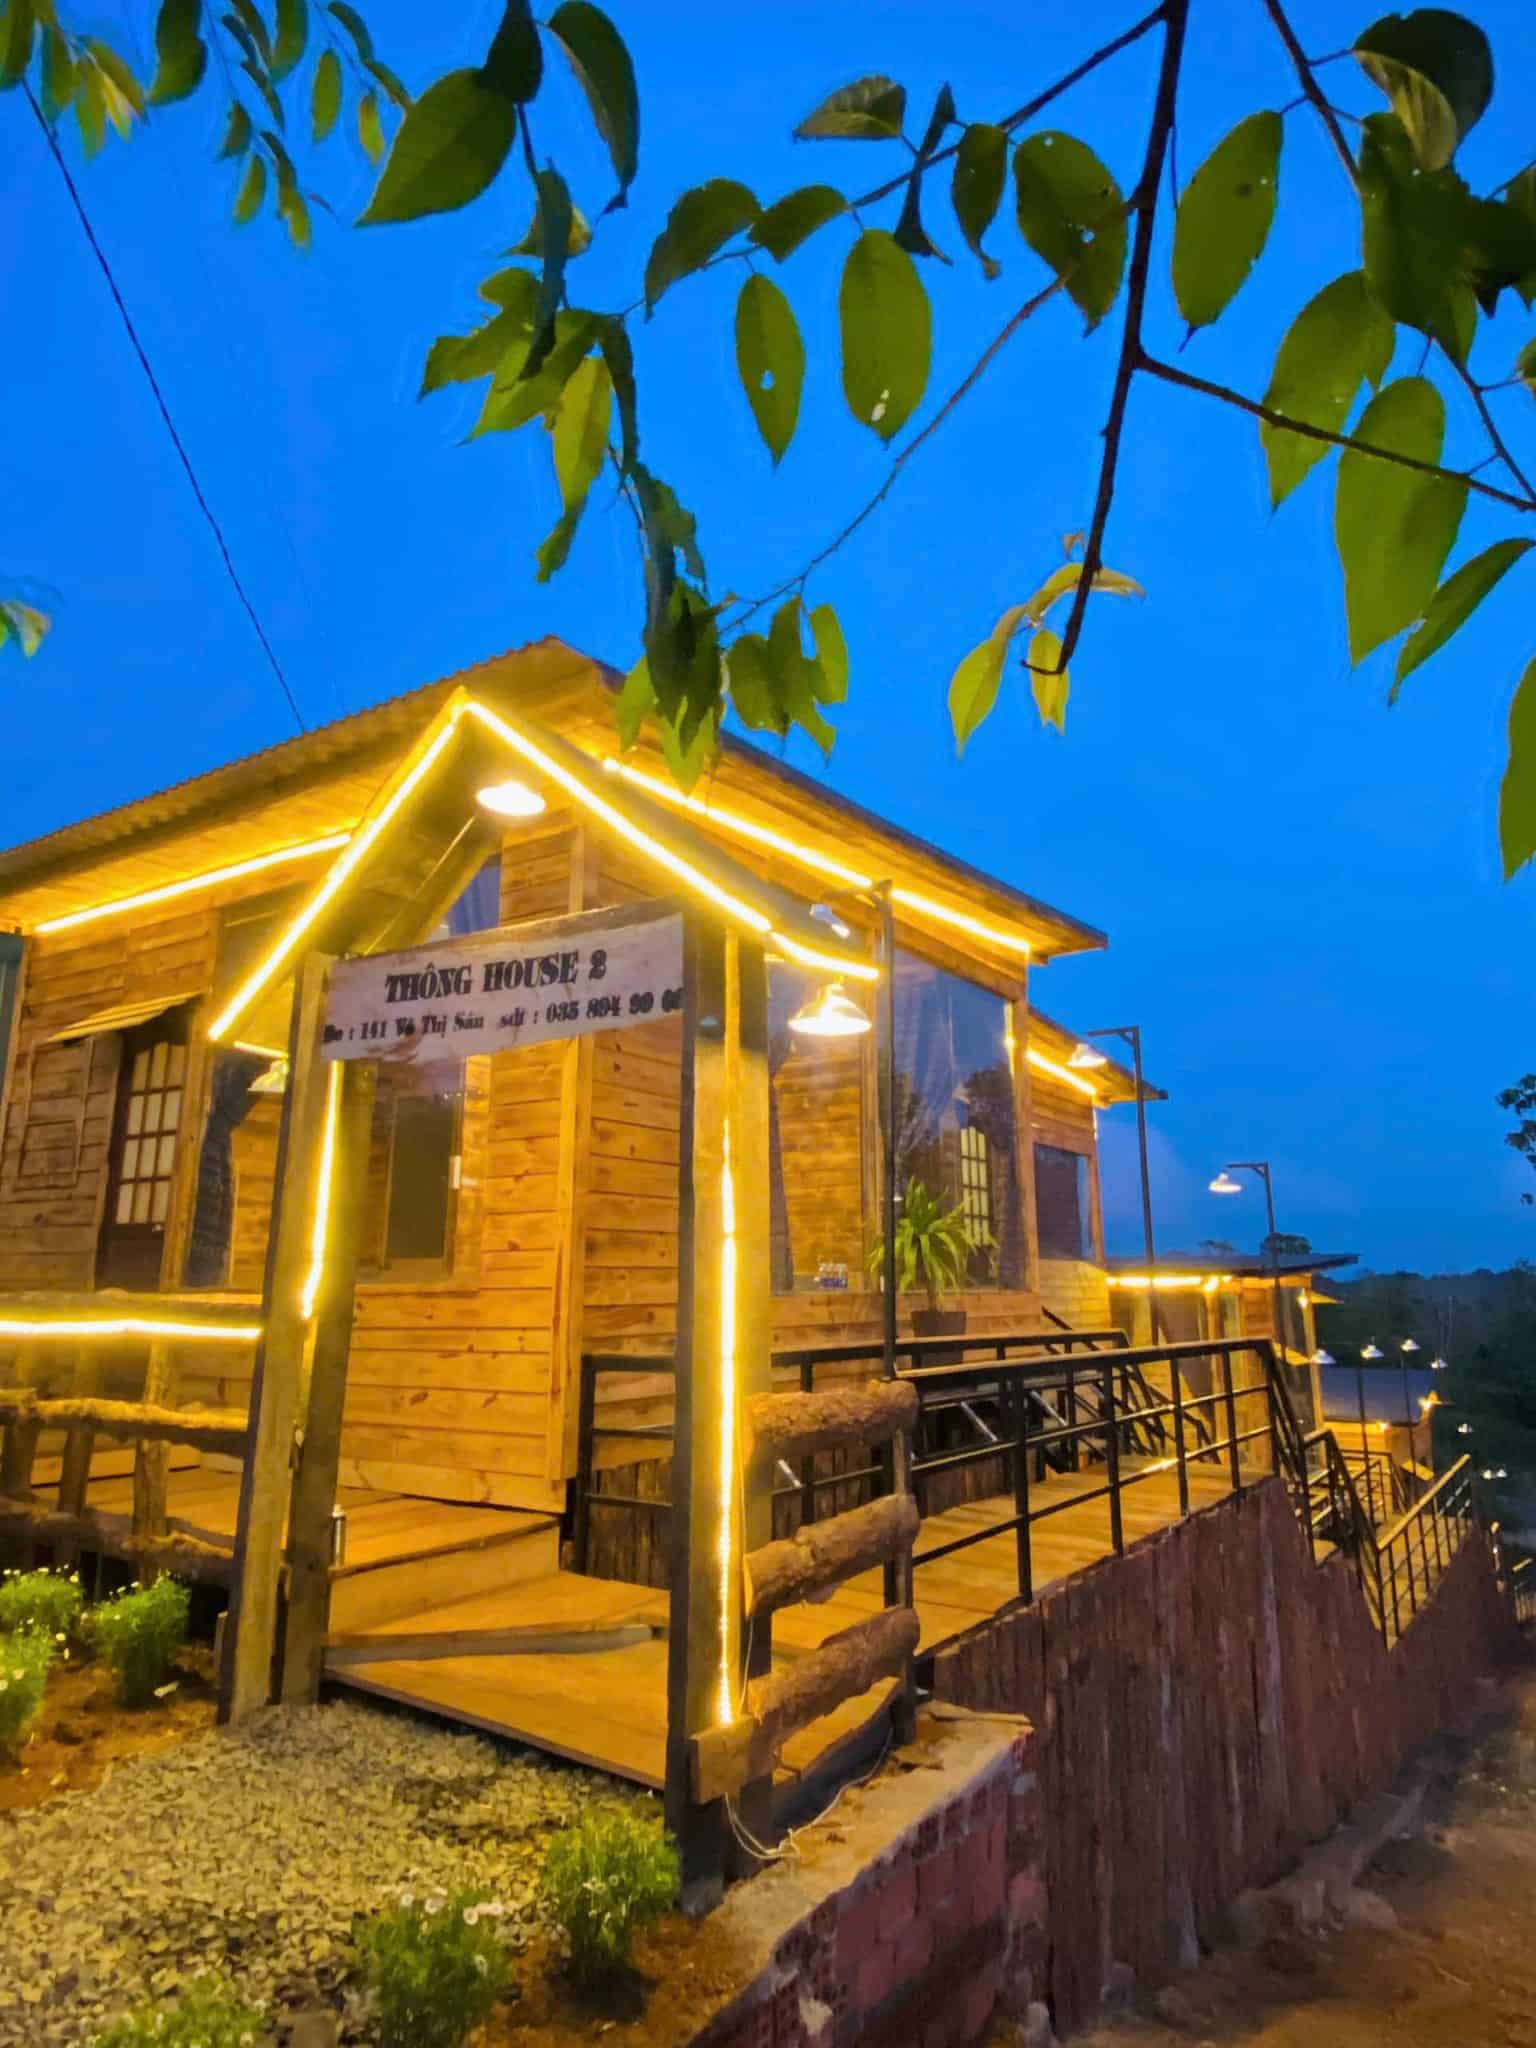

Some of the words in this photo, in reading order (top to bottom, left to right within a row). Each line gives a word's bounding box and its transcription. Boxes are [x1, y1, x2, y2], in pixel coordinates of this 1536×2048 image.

[385, 962, 472, 1003] THÔNG
[482, 951, 578, 993] HOUSE
[588, 949, 608, 980] 2
[361, 1021, 387, 1040] 141
[546, 1000, 579, 1023] 035
[586, 995, 621, 1018] 894
